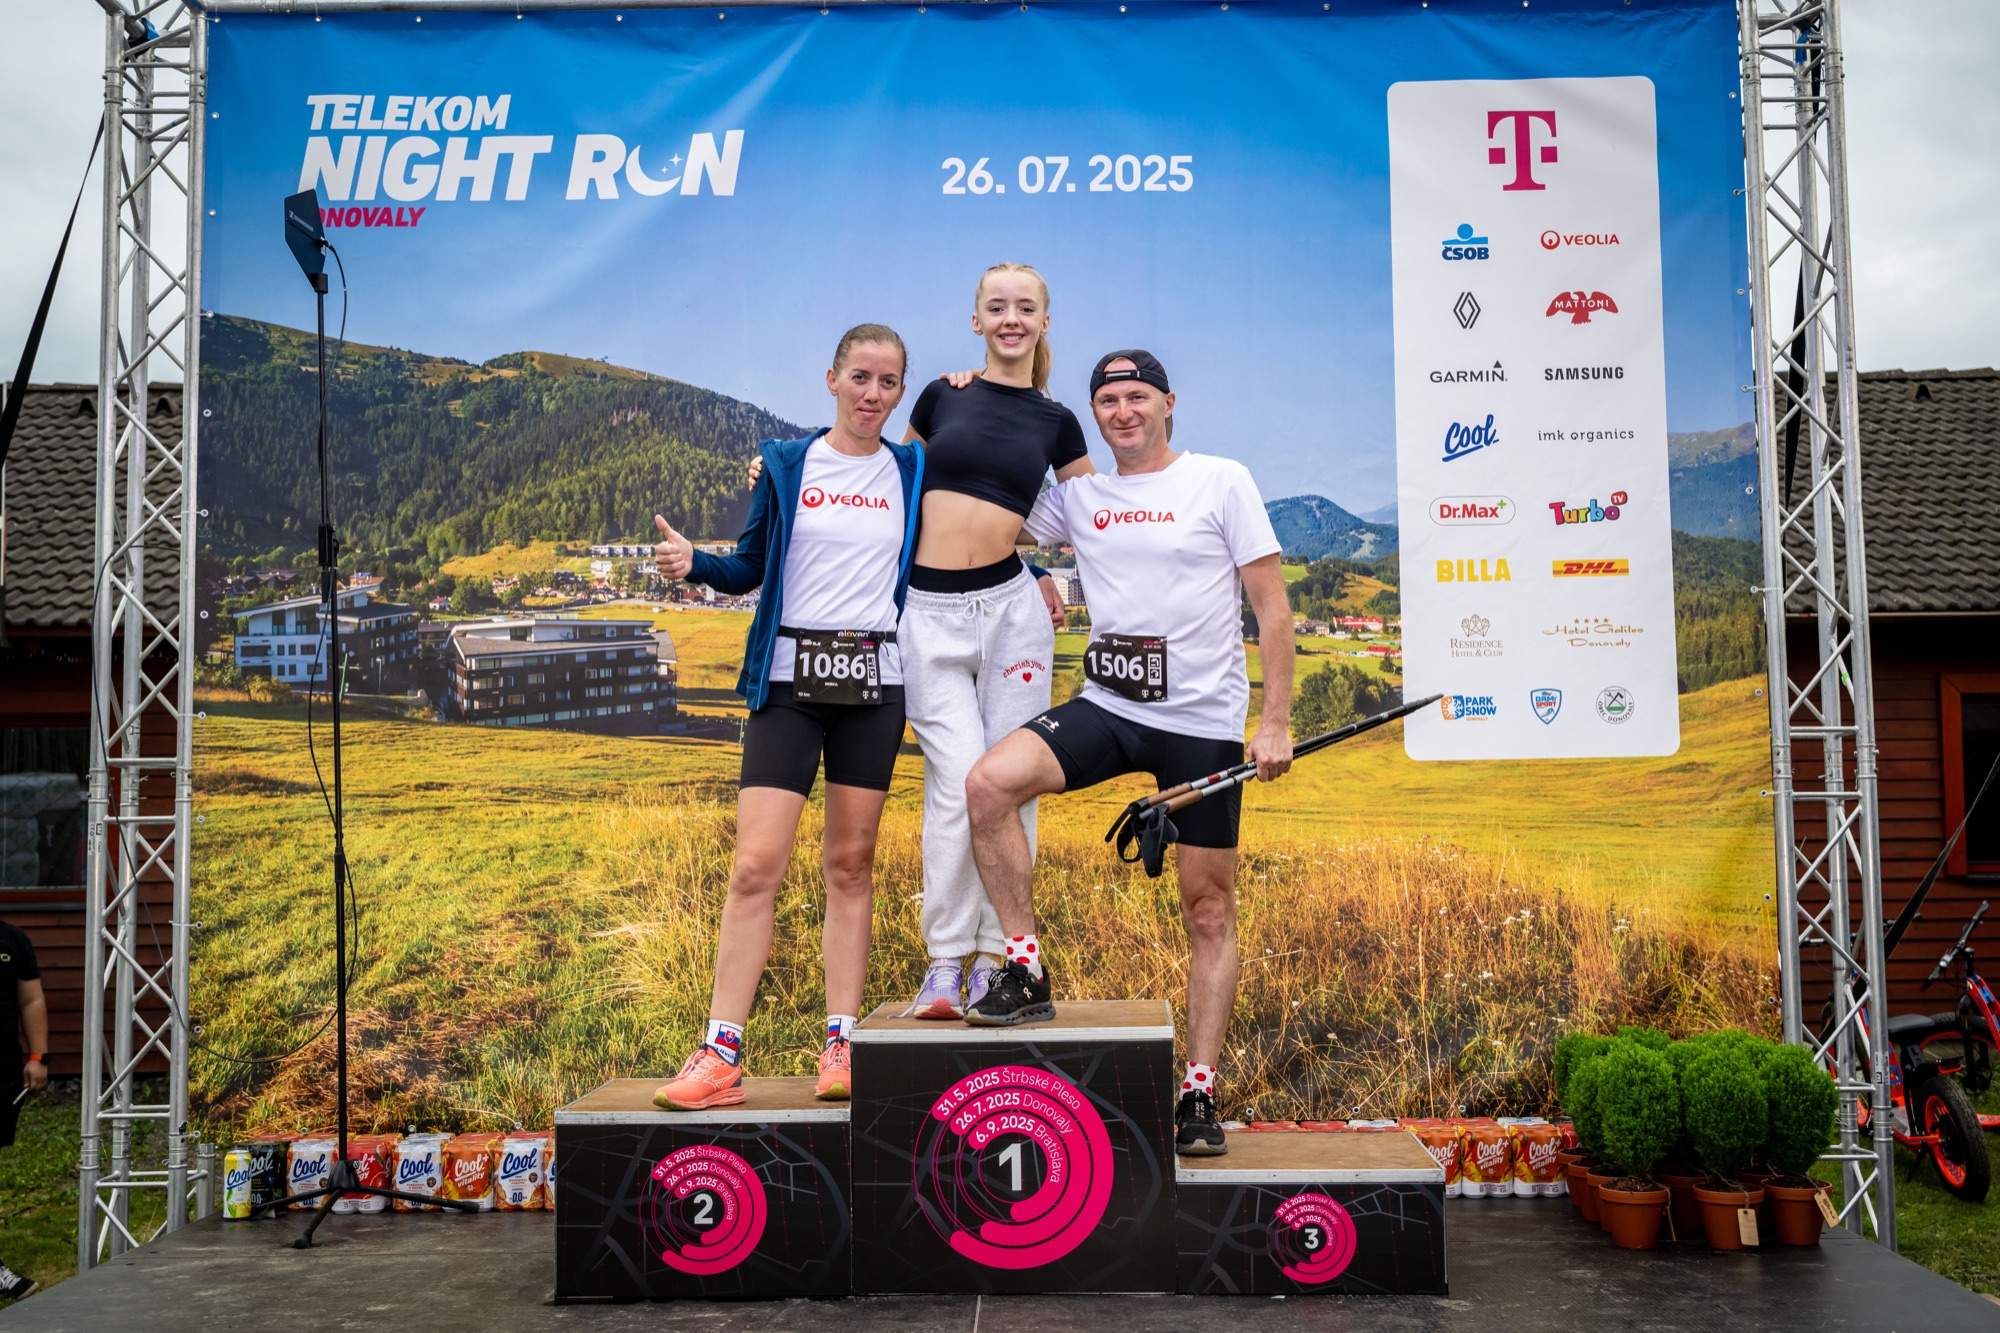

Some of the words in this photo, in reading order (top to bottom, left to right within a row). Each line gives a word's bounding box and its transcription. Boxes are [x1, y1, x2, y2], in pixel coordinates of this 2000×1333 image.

[307, 94, 511, 130] TELEKOM
[1487, 110, 1558, 191] T
[297, 136, 554, 202] NIGHT
[941, 157, 1006, 194] 26.
[1018, 156, 1076, 193] 07.
[1088, 154, 1193, 192] 2025
[1563, 234, 1620, 246] VEOLIA
[1441, 245, 1490, 261] ČSOB
[1555, 299, 1610, 308] MATTONI
[1430, 370, 1505, 383] GARMIN
[1544, 366, 1624, 381] SAMSUNG
[1442, 414, 1500, 462] Cool
[1538, 430, 1564, 441] imk
[1570, 429, 1634, 442] organics
[828, 493, 890, 510] VEOLIA
[1439, 503, 1500, 519] Dr.Max
[1549, 499, 1620, 525] Turbo
[1612, 494, 1624, 503] TV
[1114, 510, 1175, 525] VEOLIA
[1436, 559, 1512, 582] BILLA
[1561, 562, 1619, 575] DHL
[1543, 625, 1589, 635] Hotel
[1593, 624, 1644, 634] Galileo
[1450, 638, 1503, 648] RESIDENCE
[1476, 648, 1482, 656] &
[800, 652, 866, 680] 1086
[1088, 651, 1144, 681] 1506
[1466, 696, 1493, 706] PARK
[1466, 706, 1497, 716] SNOW
[966, 1072, 1000, 1094] 2025
[1002, 1067, 1049, 1089] Štrbské
[1050, 1080, 1080, 1110] Pleso
[986, 1093, 1020, 1110] 2025
[1023, 1094, 1074, 1135] Donovaly
[1000, 1115, 1036, 1132] 2025
[1034, 1124, 1064, 1183] Bratislava
[292, 1154, 327, 1183] Cool
[399, 1152, 434, 1184] Cool
[501, 1148, 537, 1179] Cool
[674, 1149, 696, 1162] 2025
[728, 1154, 747, 1174] Pleso
[999, 1143, 1022, 1191] 1
[1480, 1156, 1504, 1170] vitality
[1532, 1156, 1556, 1170] vitality
[457, 1172, 485, 1188] vitality
[686, 1162, 709, 1173] 2025
[710, 1163, 741, 1190] Donovaly
[693, 1193, 714, 1224] 2
[695, 1176, 718, 1187] 2025
[716, 1182, 734, 1220] Bratislava
[1305, 1228, 1319, 1249] 3
